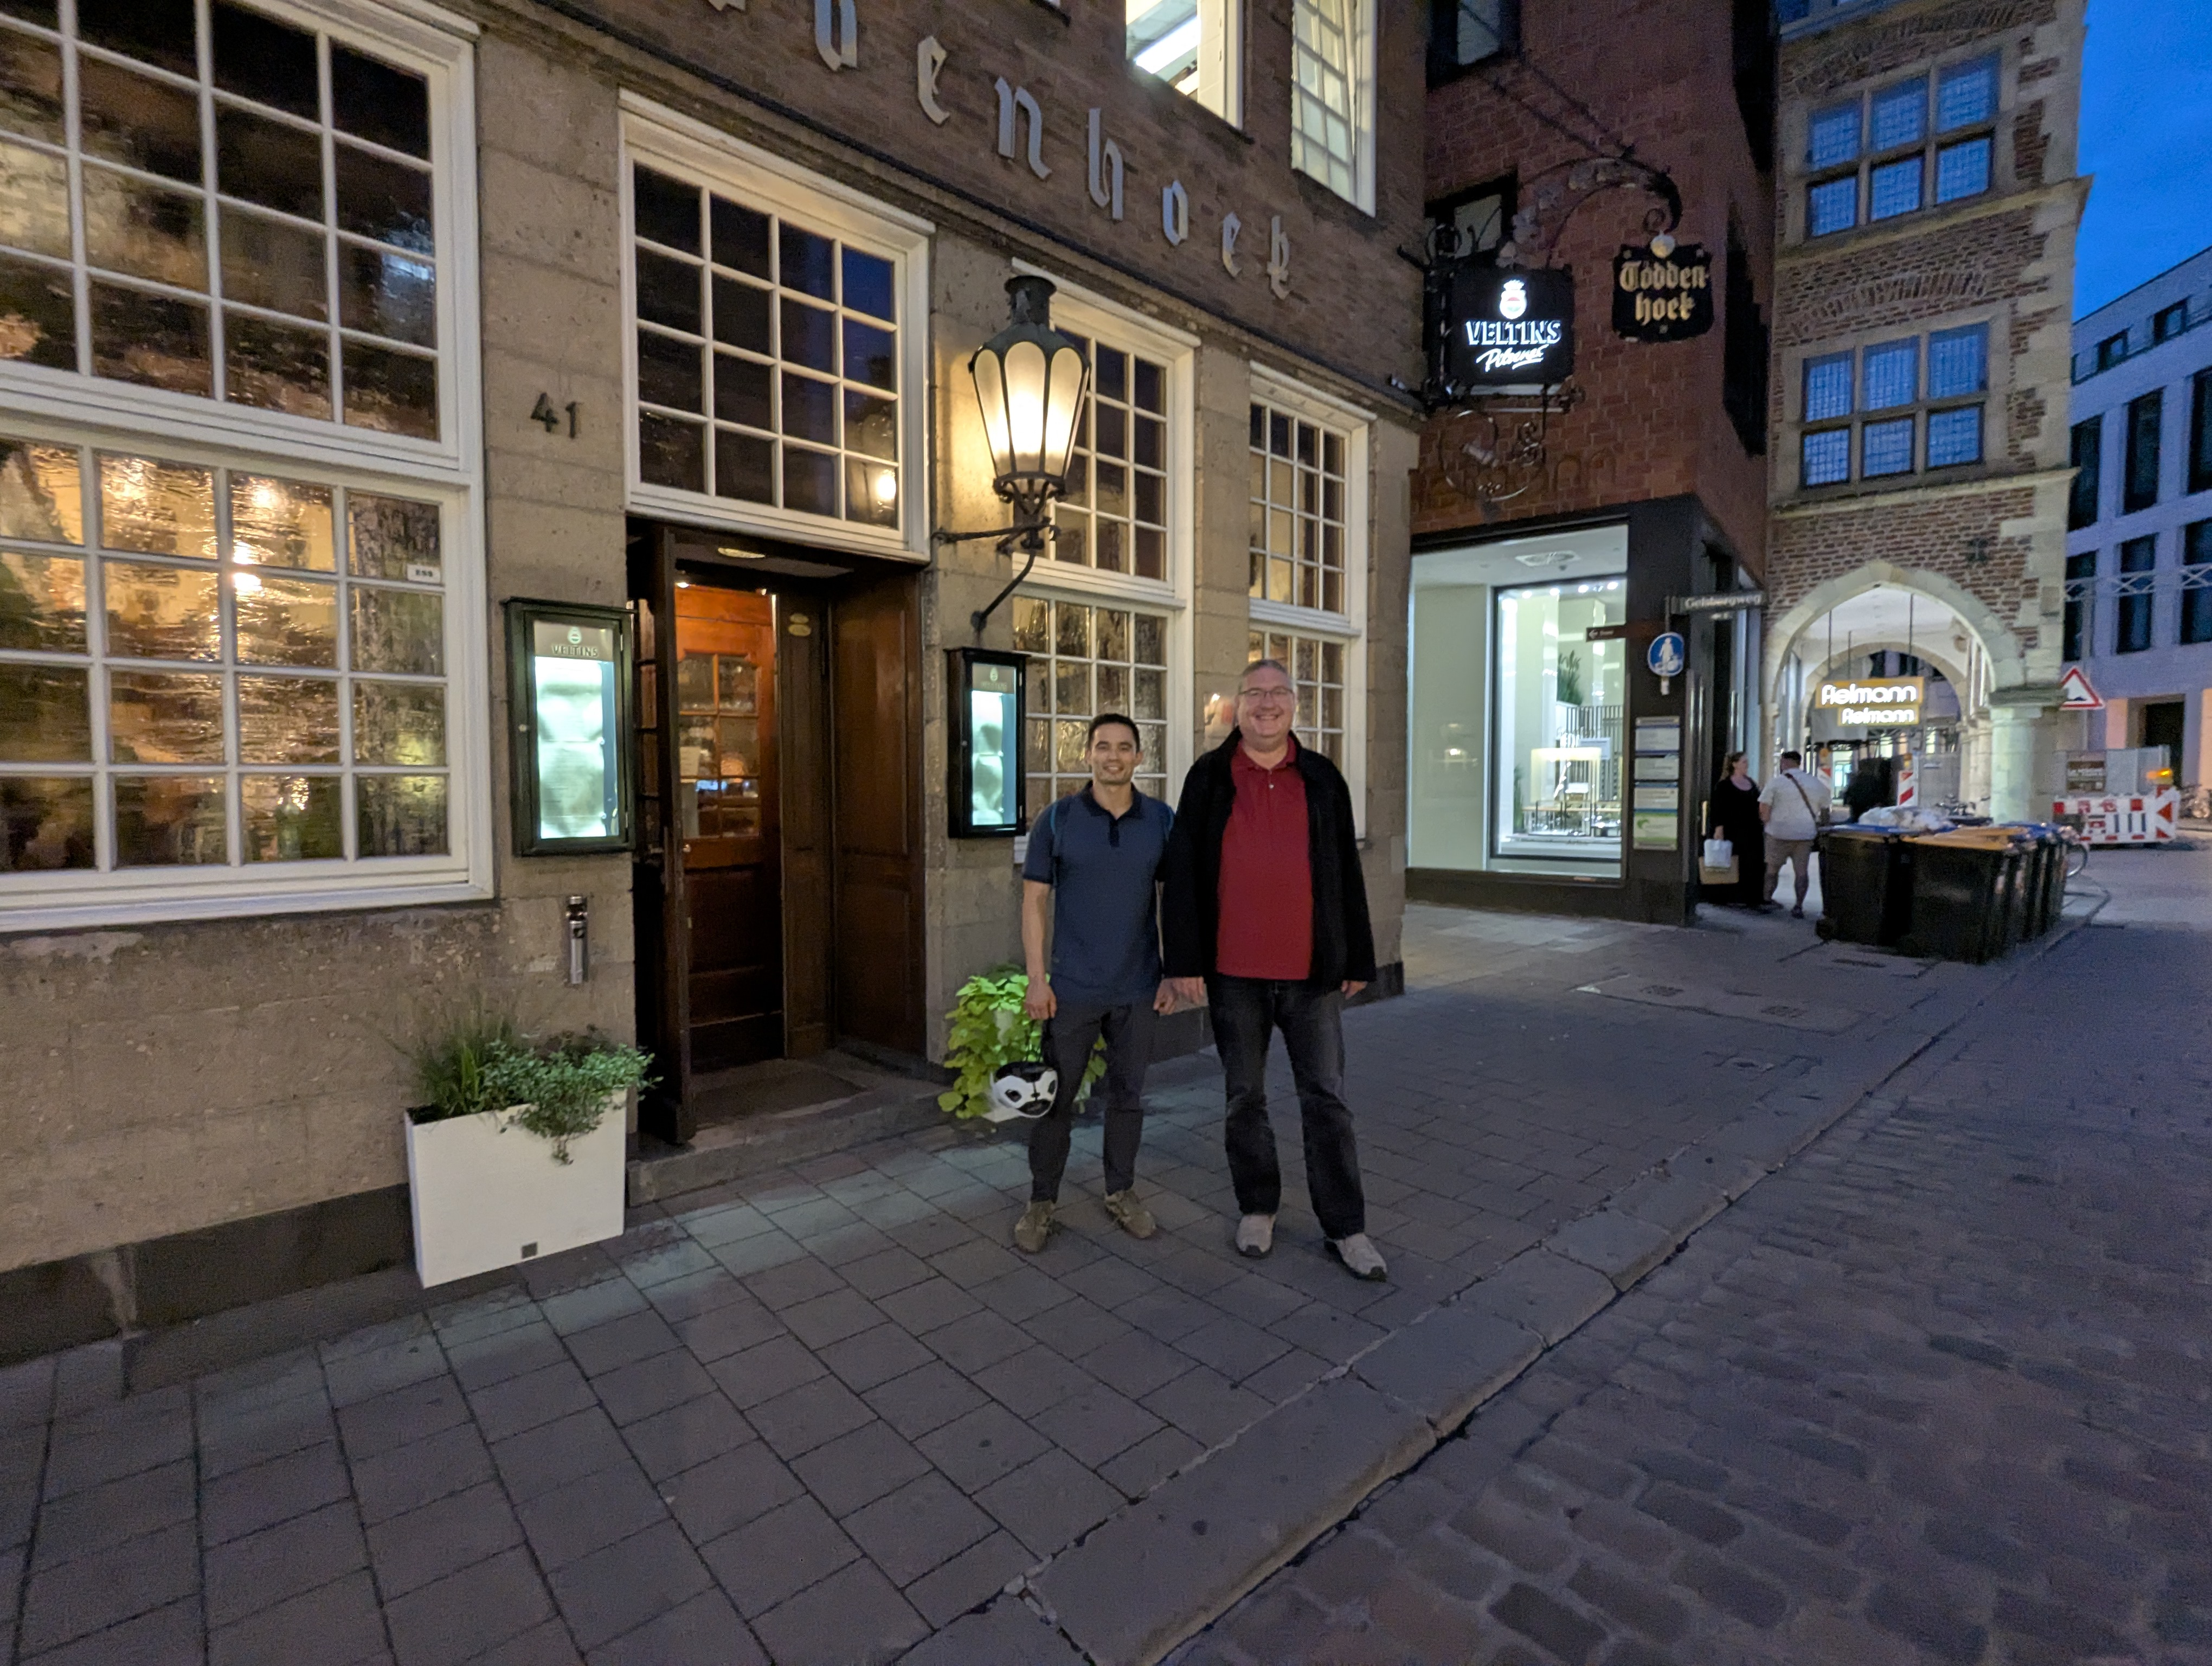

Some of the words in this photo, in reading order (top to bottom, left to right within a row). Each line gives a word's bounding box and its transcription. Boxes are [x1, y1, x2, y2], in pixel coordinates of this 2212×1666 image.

[1635, 291, 1695, 326] hoek
[1465, 319, 1562, 345] VELTINS
[1475, 344, 1550, 373] Pilsener
[530, 392, 581, 438] 41
[551, 644, 599, 657] VELTINS
